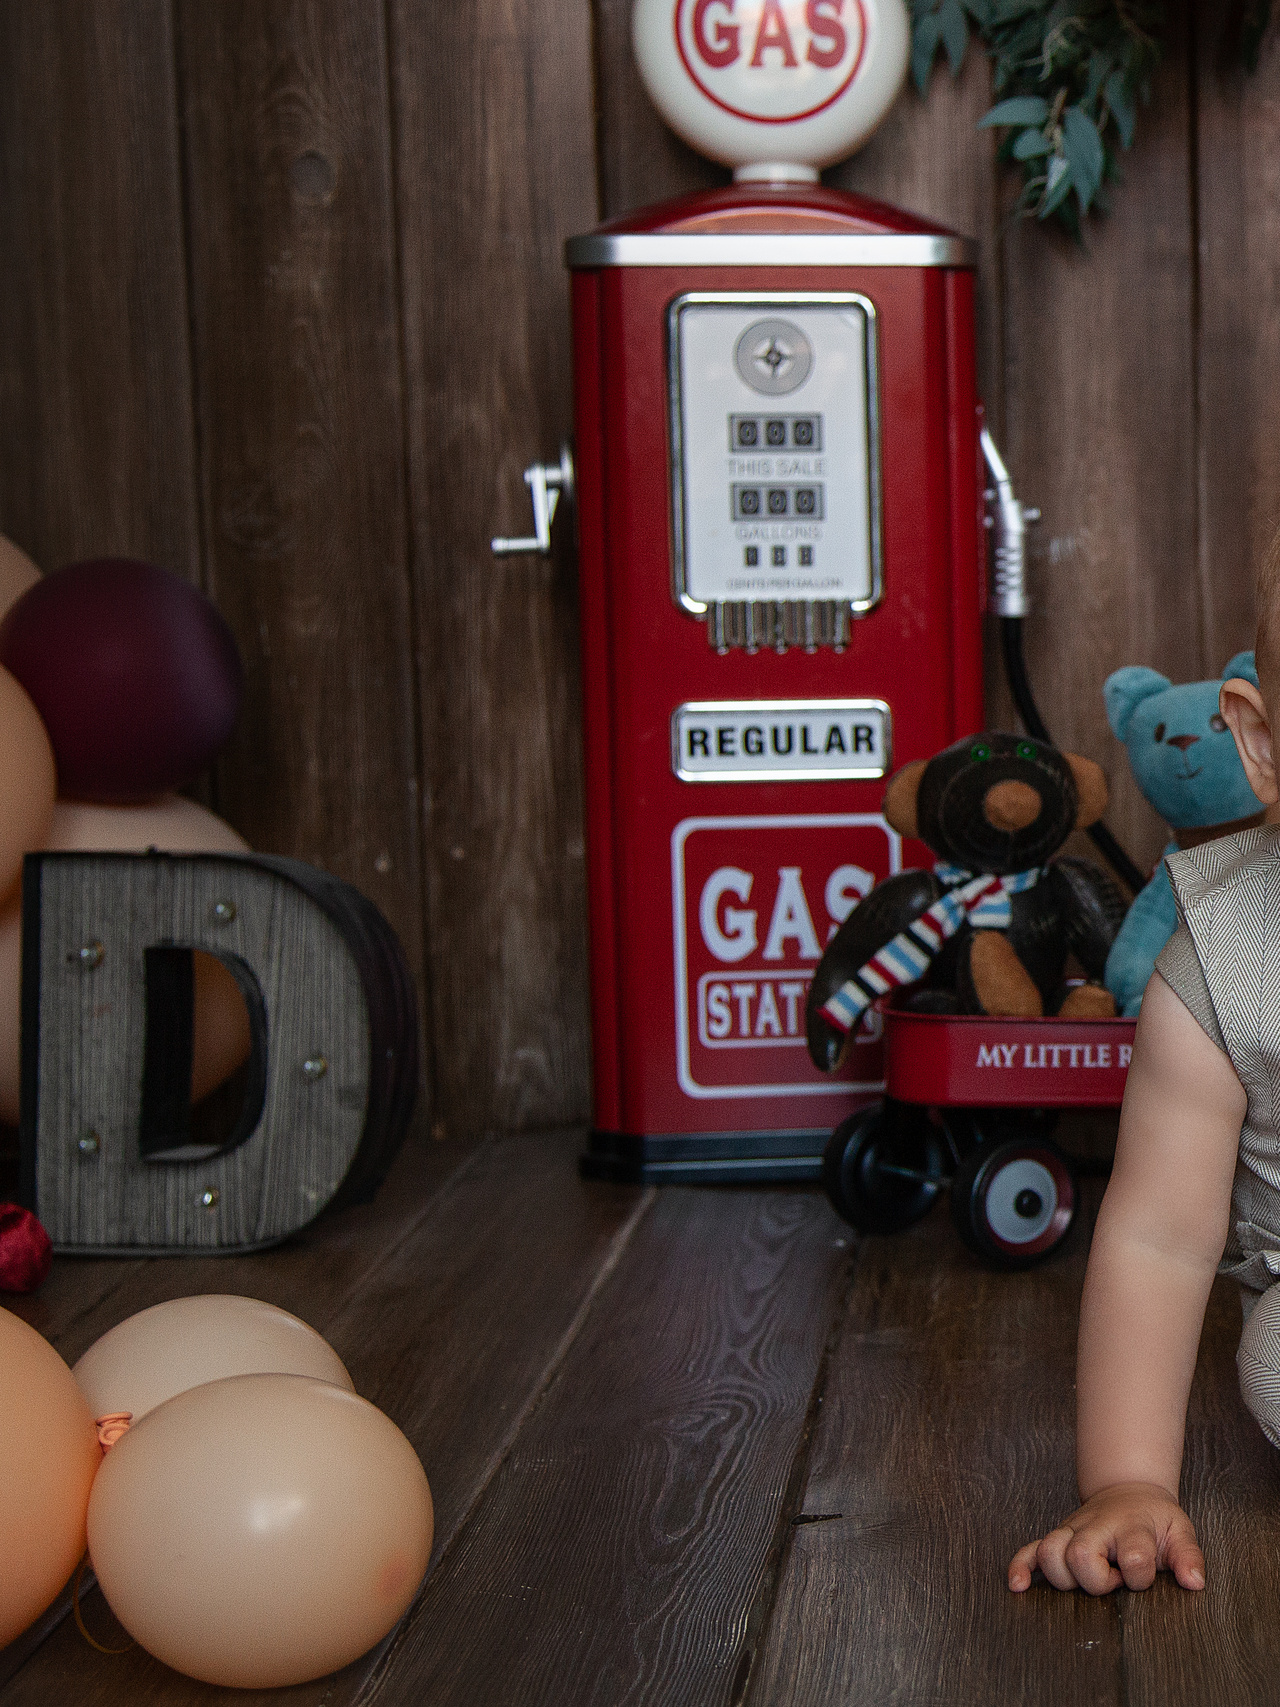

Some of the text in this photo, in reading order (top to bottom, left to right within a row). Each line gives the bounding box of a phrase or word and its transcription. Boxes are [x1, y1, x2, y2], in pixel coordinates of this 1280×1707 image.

[693, 0, 847, 68] GAS
[729, 458, 825, 476] THIS SALE
[736, 524, 822, 540] GALLONS
[687, 724, 874, 757] REGULAR
[707, 982, 873, 1038] STAT
[976, 1043, 1133, 1068] MY LITTLE R
